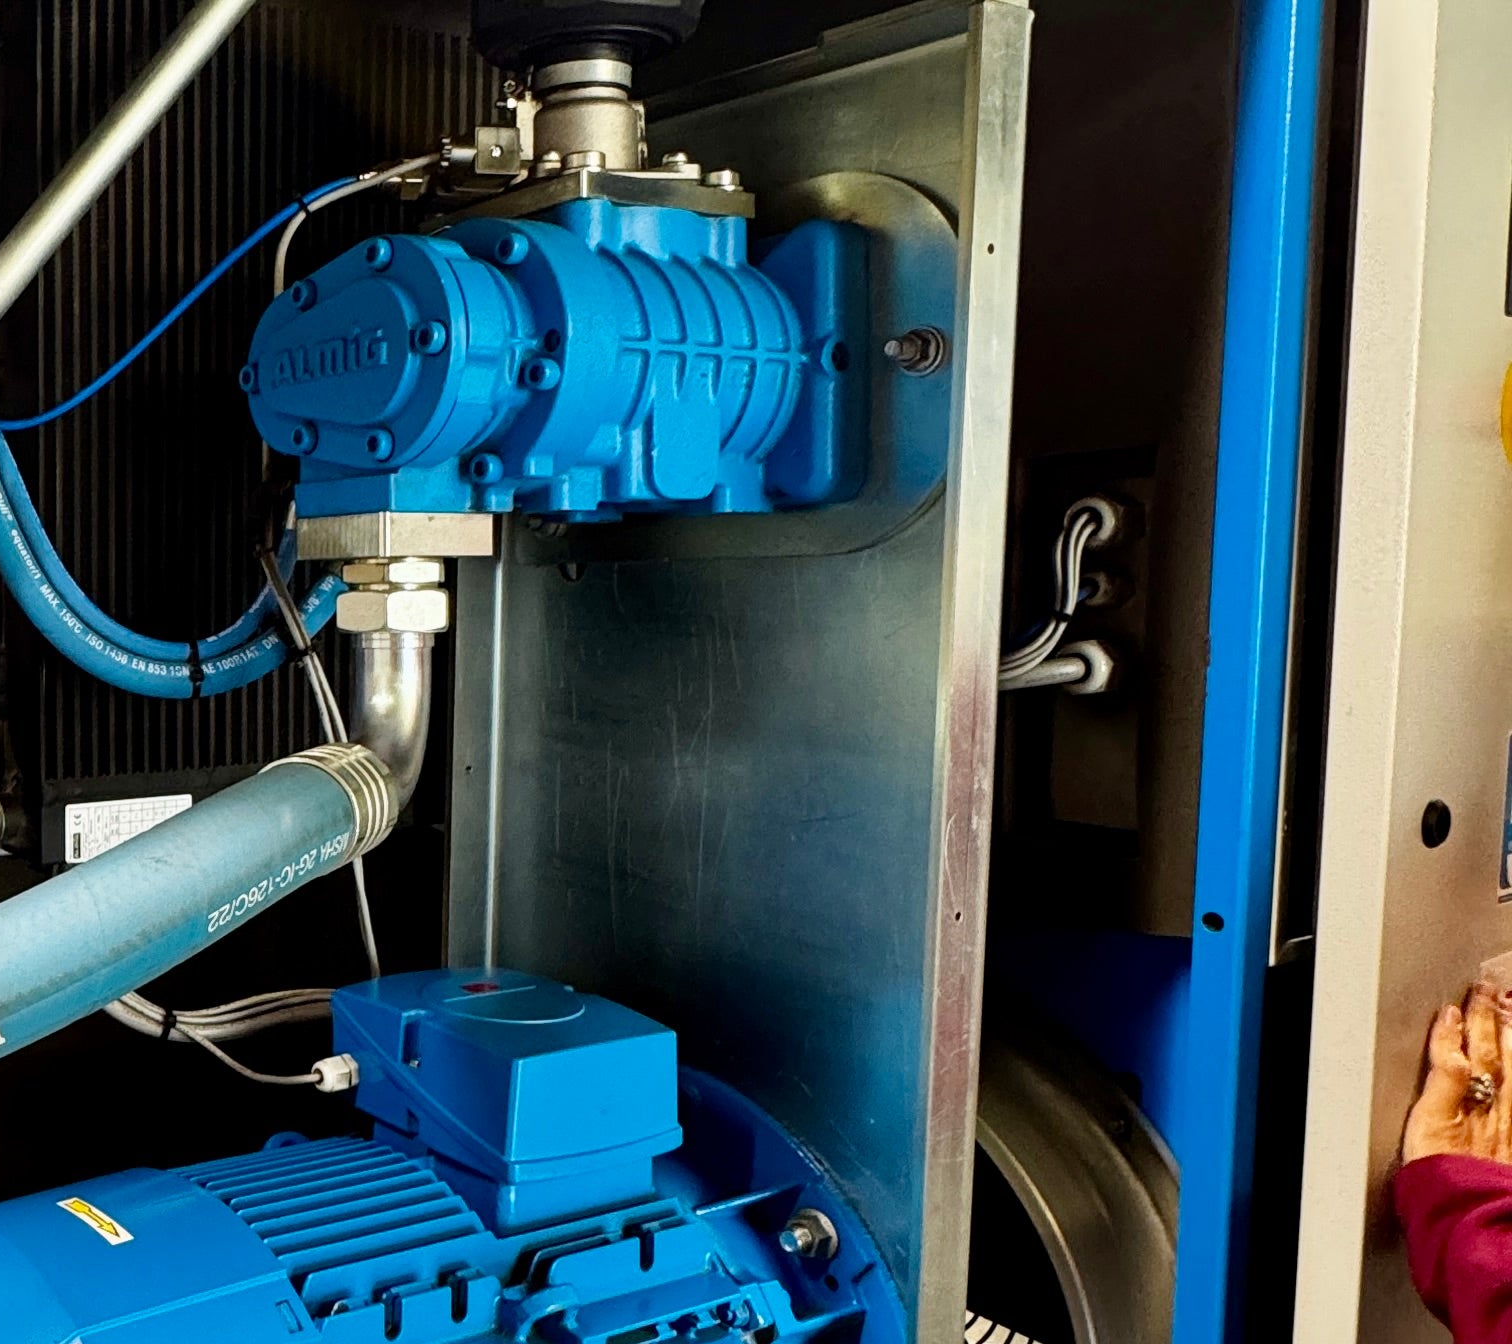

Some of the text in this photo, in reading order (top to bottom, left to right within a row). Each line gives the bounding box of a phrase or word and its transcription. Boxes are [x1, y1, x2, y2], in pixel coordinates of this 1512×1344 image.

[84, 633, 105, 650] ISO
[131, 658, 146, 672] EN
[147, 662, 167, 676] 853
[262, 633, 280, 650] DN
[319, 575, 337, 592] WP
